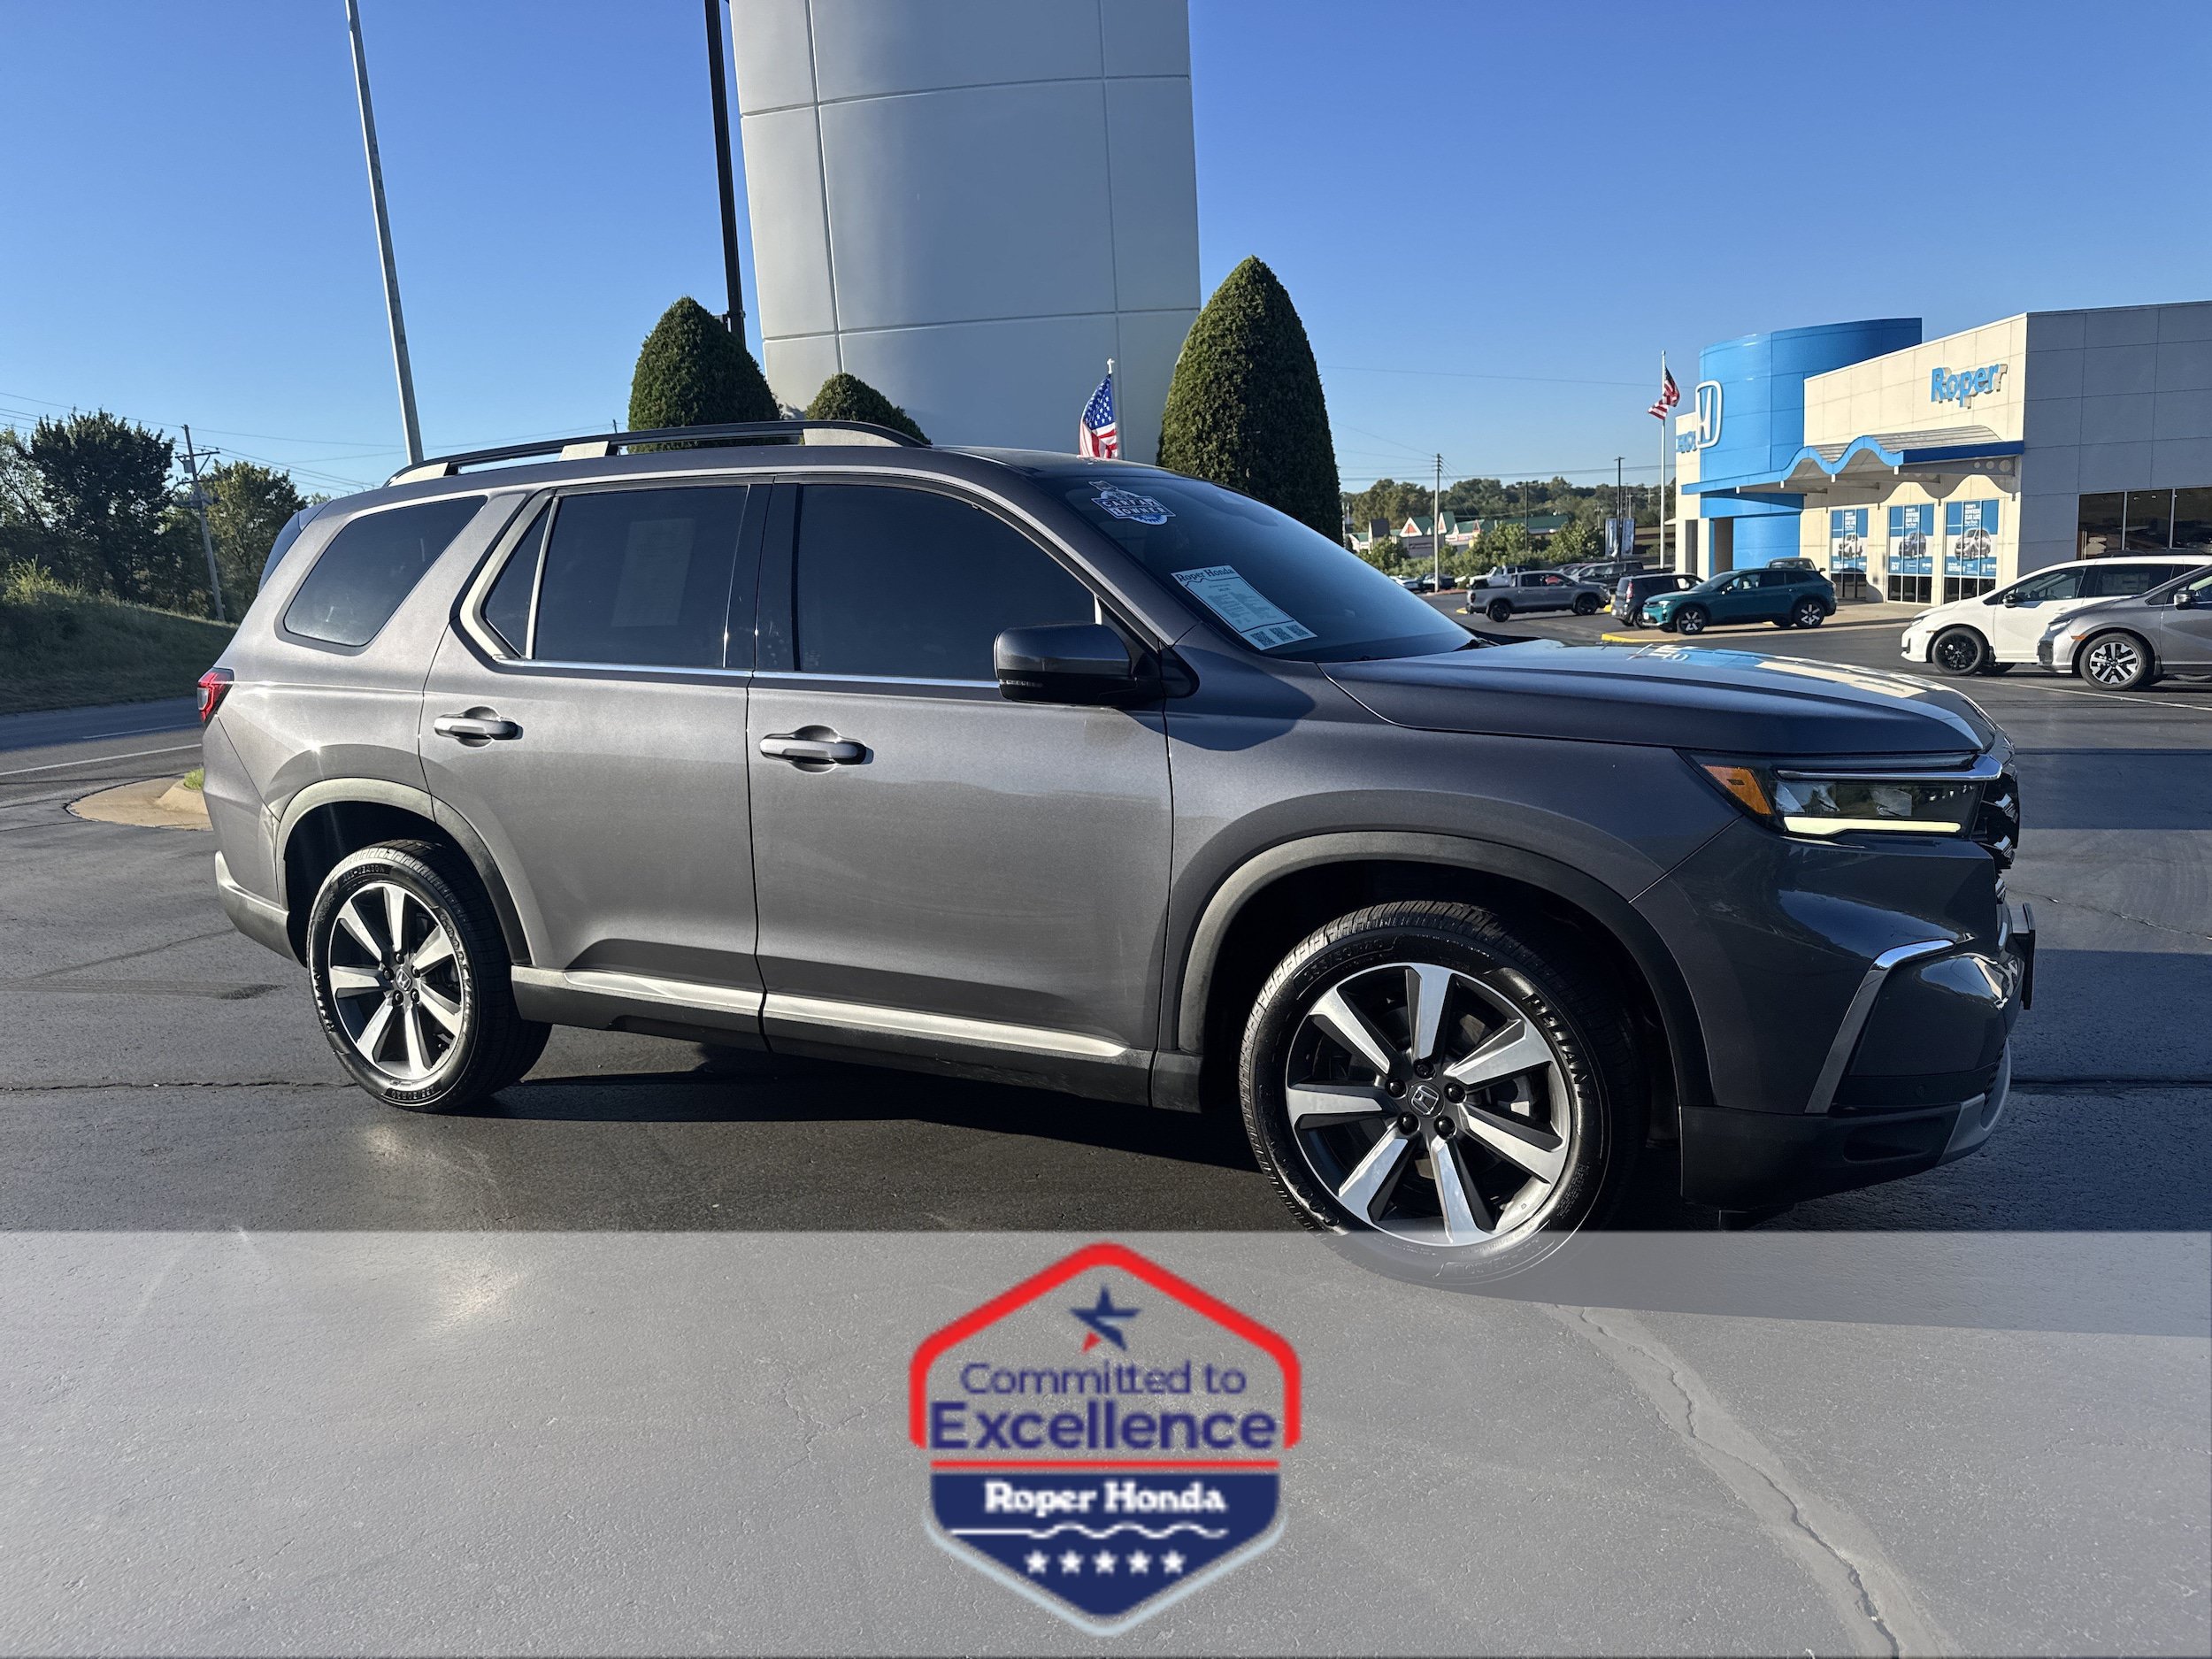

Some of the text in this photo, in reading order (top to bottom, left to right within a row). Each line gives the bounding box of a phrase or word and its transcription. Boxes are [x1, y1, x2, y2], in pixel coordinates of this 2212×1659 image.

[1931, 364, 2004, 408] Roper
[1102, 498, 1160, 508] CARFAX
[1175, 567, 1236, 582] Roper Honda
